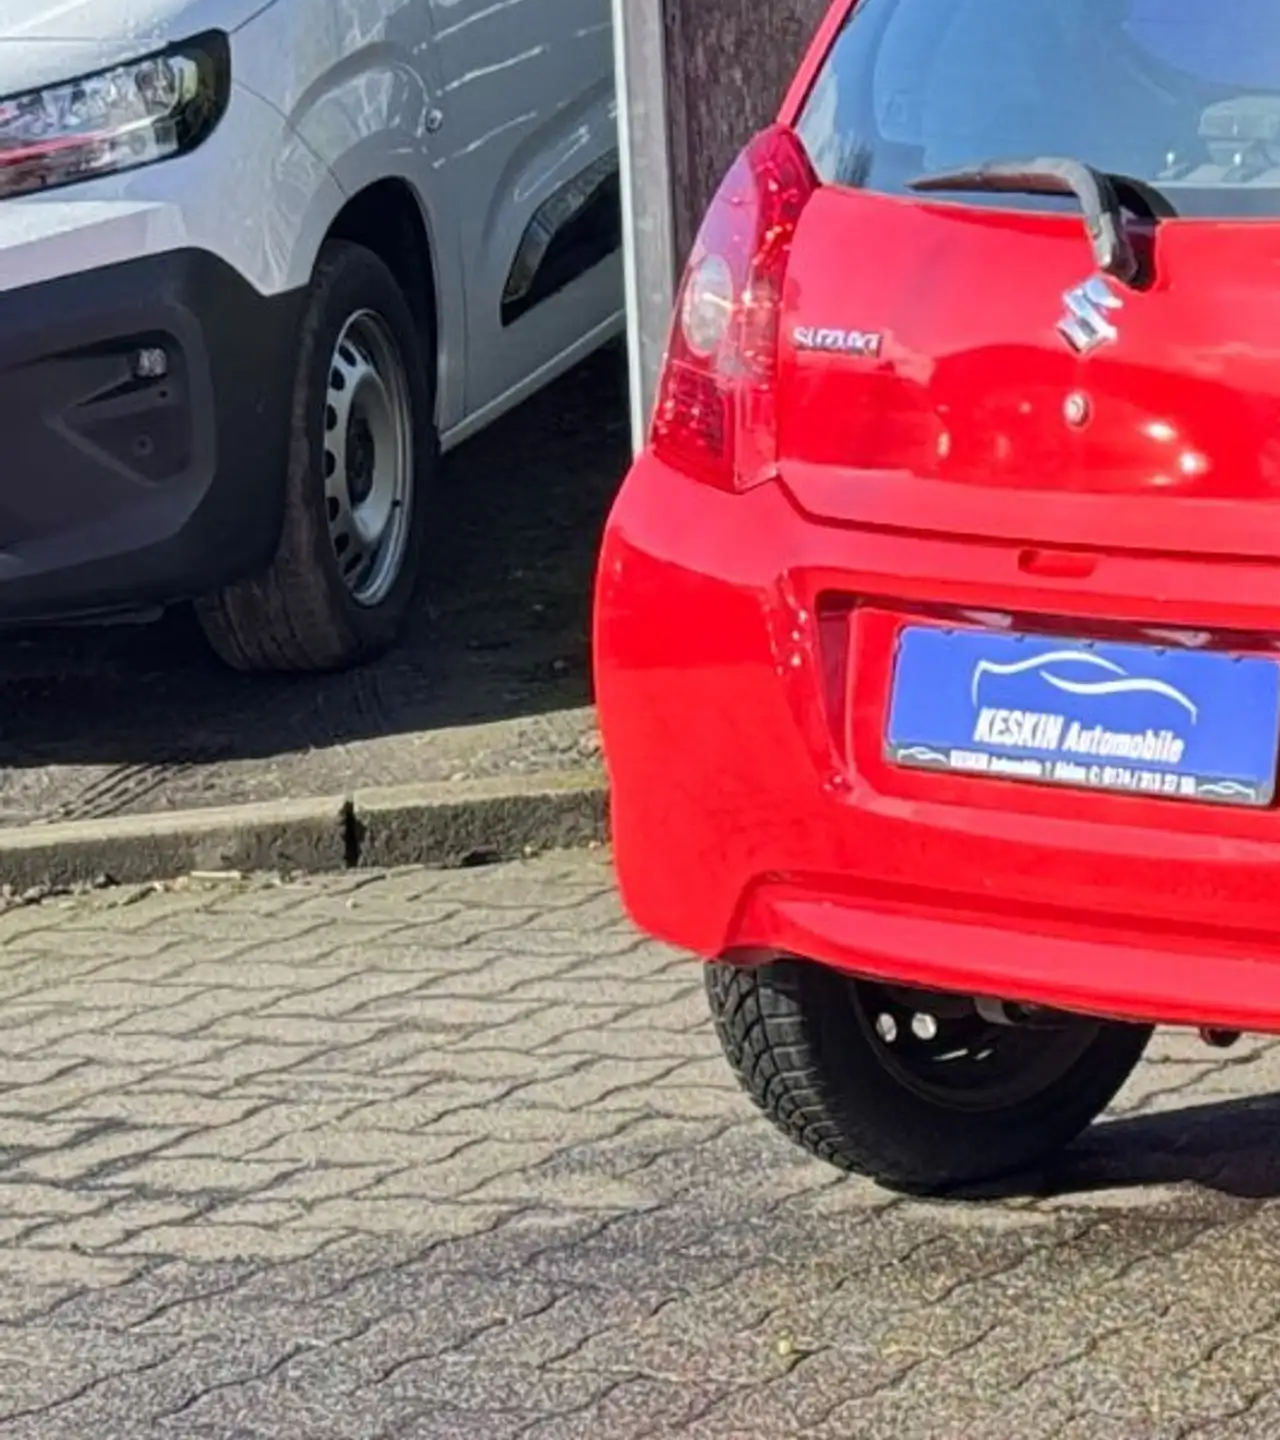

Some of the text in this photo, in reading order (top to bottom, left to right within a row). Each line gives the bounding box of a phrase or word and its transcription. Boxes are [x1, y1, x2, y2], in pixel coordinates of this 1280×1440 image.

[793, 327, 882, 357] SUZUKI
[973, 707, 1186, 764] KESKIN Automobile
